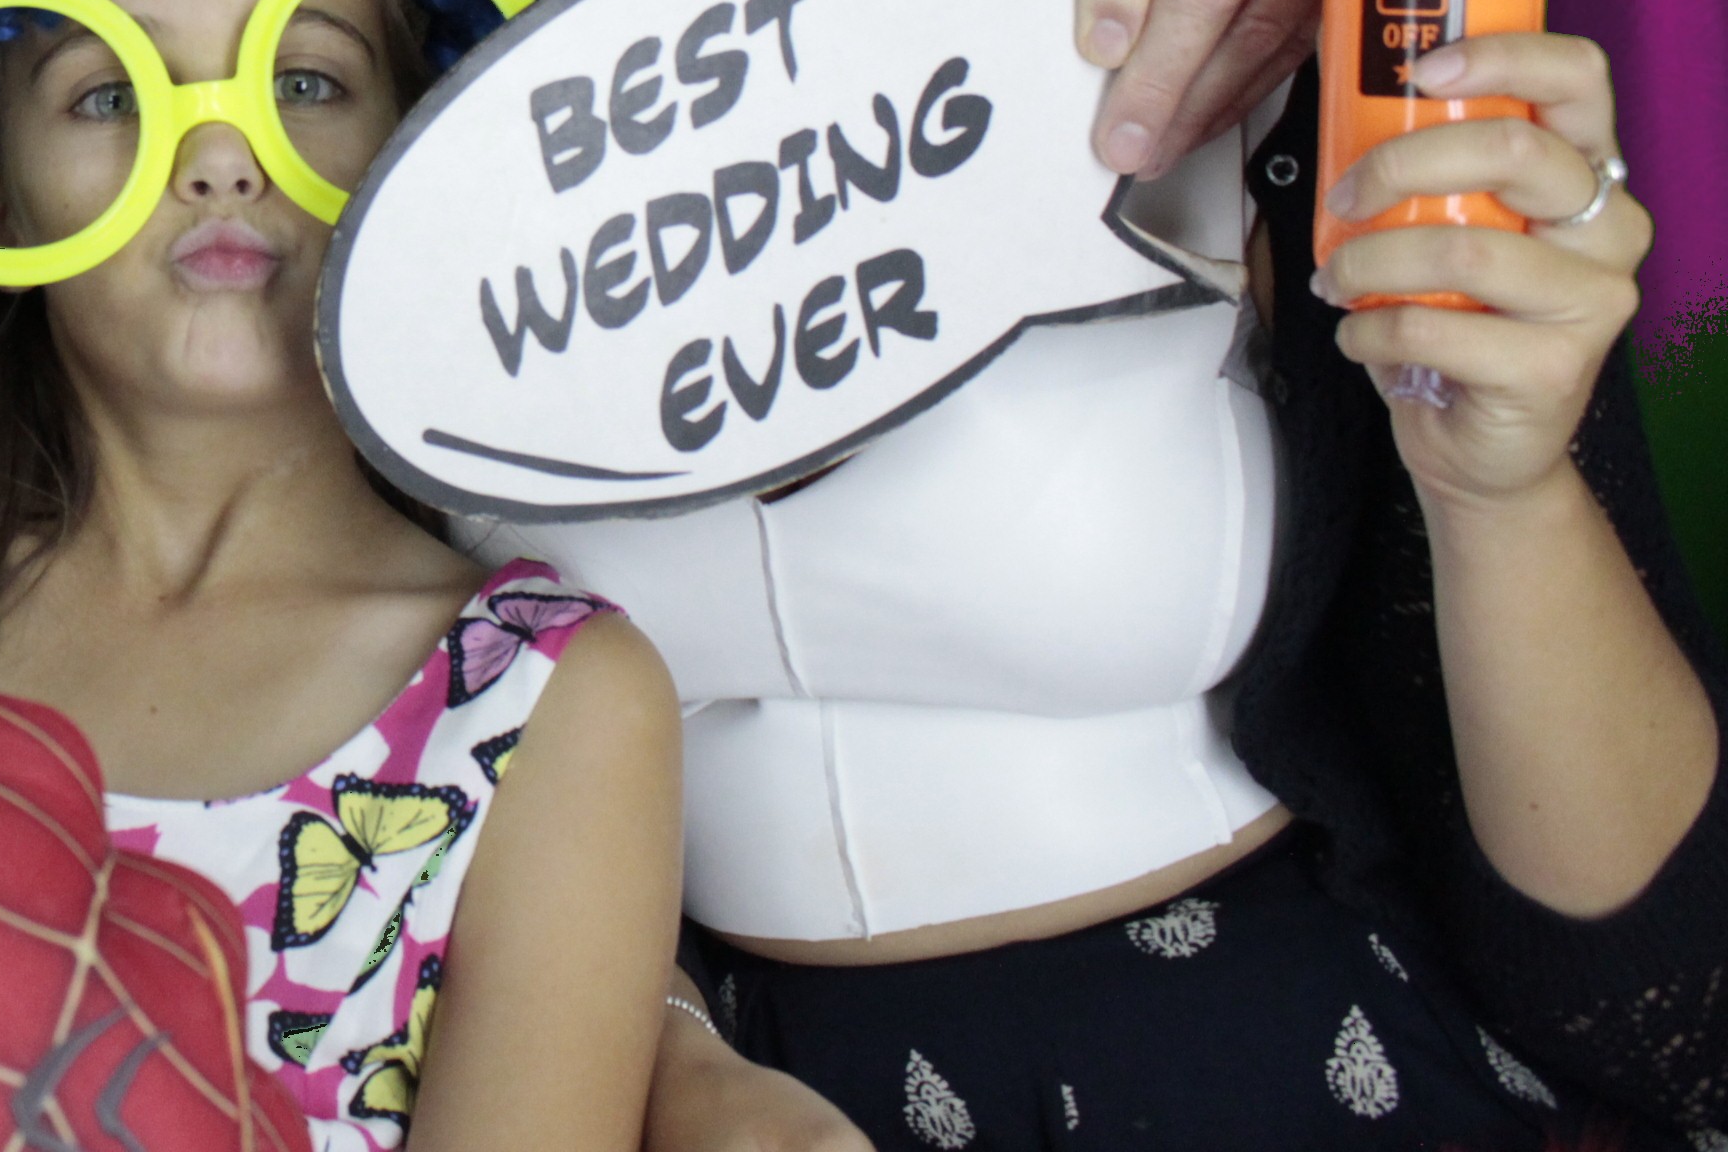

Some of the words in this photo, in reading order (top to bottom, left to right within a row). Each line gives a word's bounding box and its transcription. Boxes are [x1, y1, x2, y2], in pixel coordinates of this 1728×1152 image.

[1383, 23, 1440, 48] OFF
[479, 56, 993, 377] WEDDING
[659, 248, 939, 453] EVER
